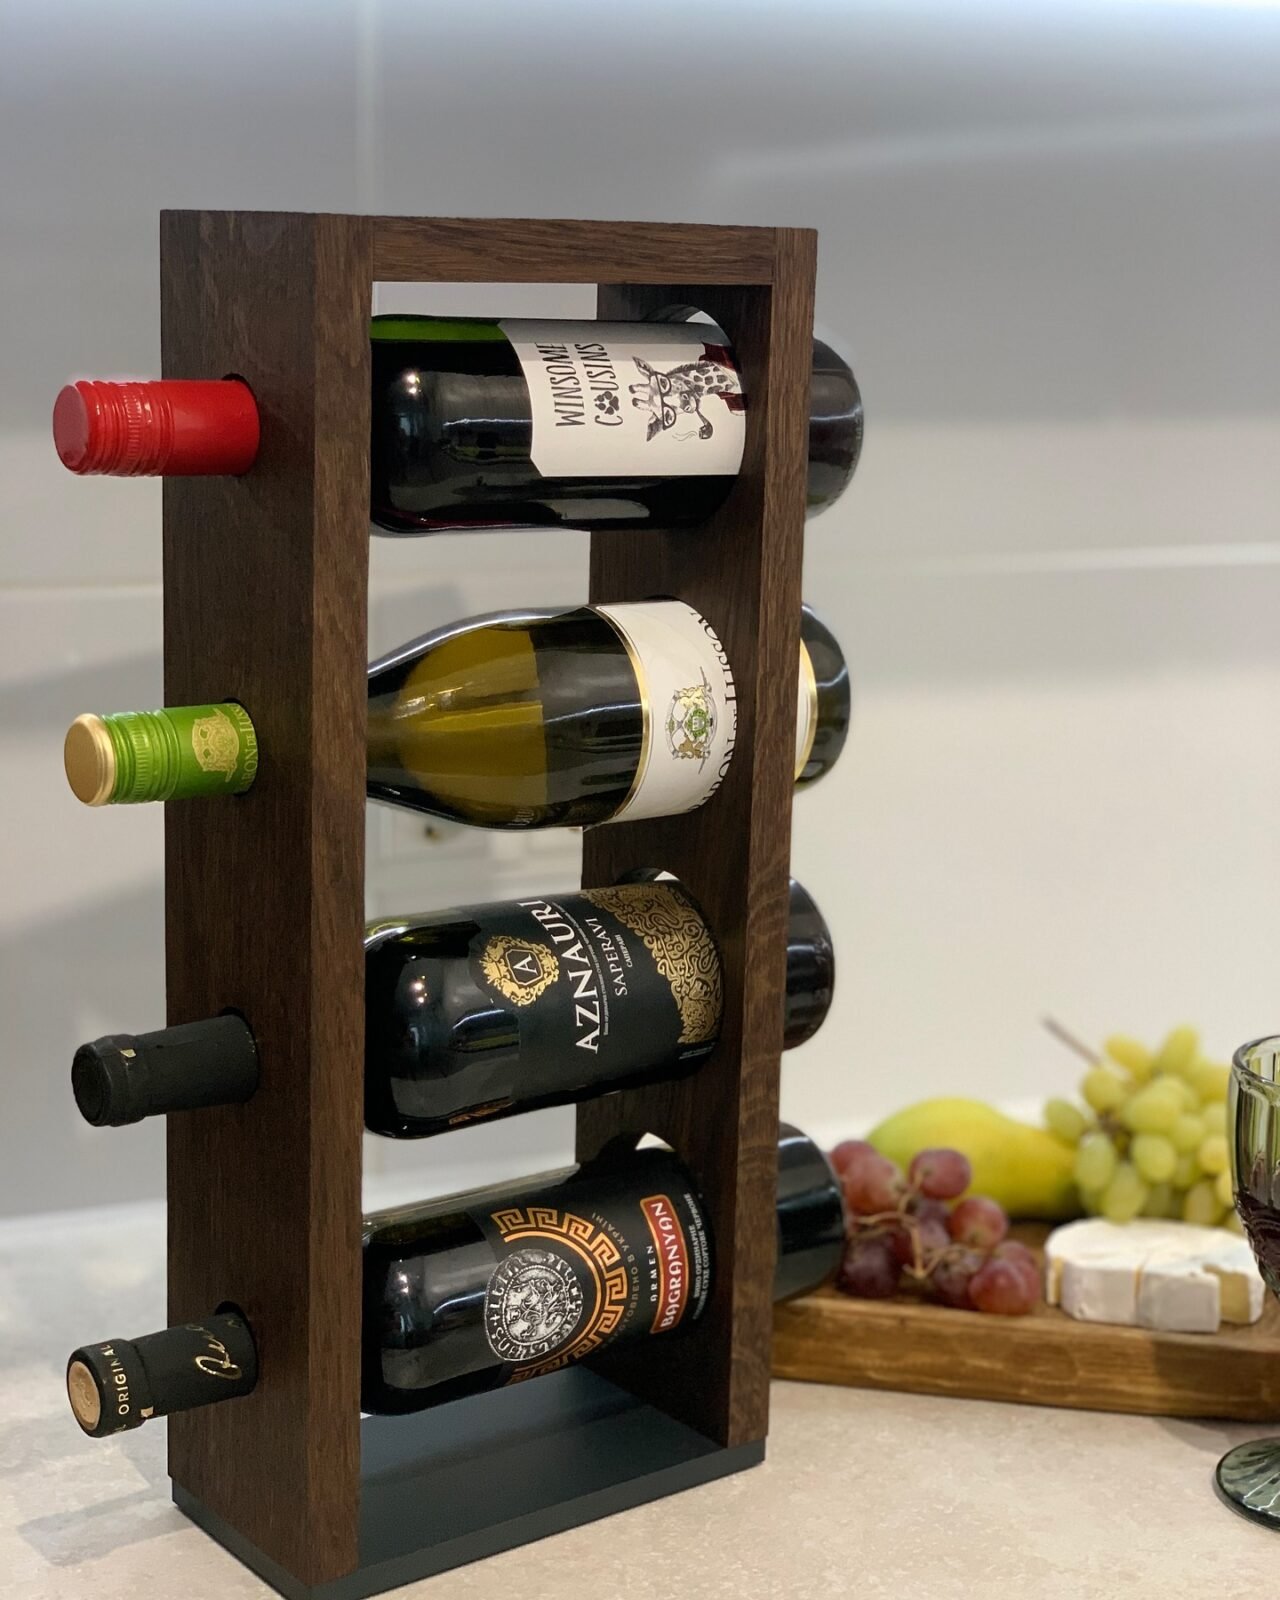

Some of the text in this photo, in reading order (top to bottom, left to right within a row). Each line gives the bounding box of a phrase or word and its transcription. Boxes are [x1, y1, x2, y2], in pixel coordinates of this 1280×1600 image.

[534, 342, 586, 427] WINSOME
[513, 953, 539, 976] A
[517, 899, 601, 1055] AZNAURI
[585, 917, 628, 996] SAPERAVI
[646, 1245, 659, 1303] ARMEN
[650, 1201, 684, 1328] BAGRANYAN
[101, 1343, 131, 1416] ORIGINAL
